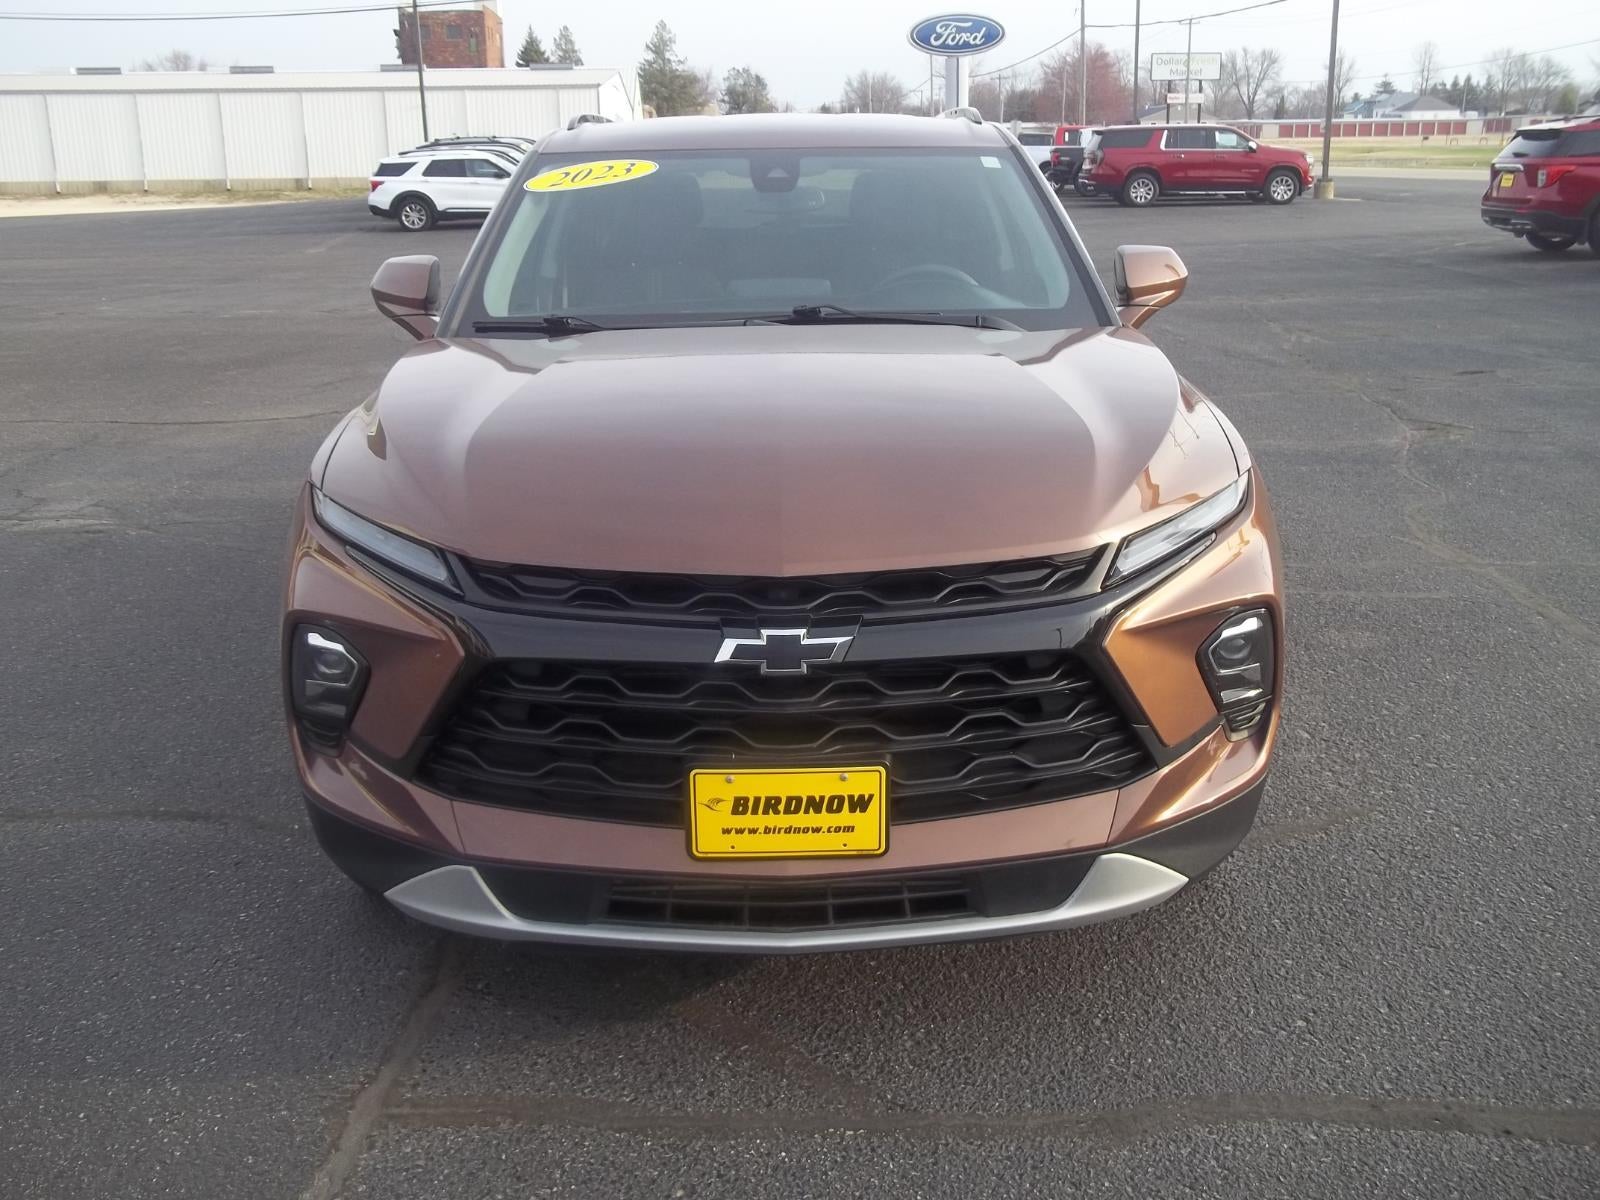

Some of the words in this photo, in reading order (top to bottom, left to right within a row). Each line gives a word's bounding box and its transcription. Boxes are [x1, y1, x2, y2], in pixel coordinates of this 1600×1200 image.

[930, 20, 986, 46] Ford
[547, 162, 635, 188] 2023
[730, 793, 874, 816] BIRDNOW
[721, 824, 856, 835] www.birdnow.com
